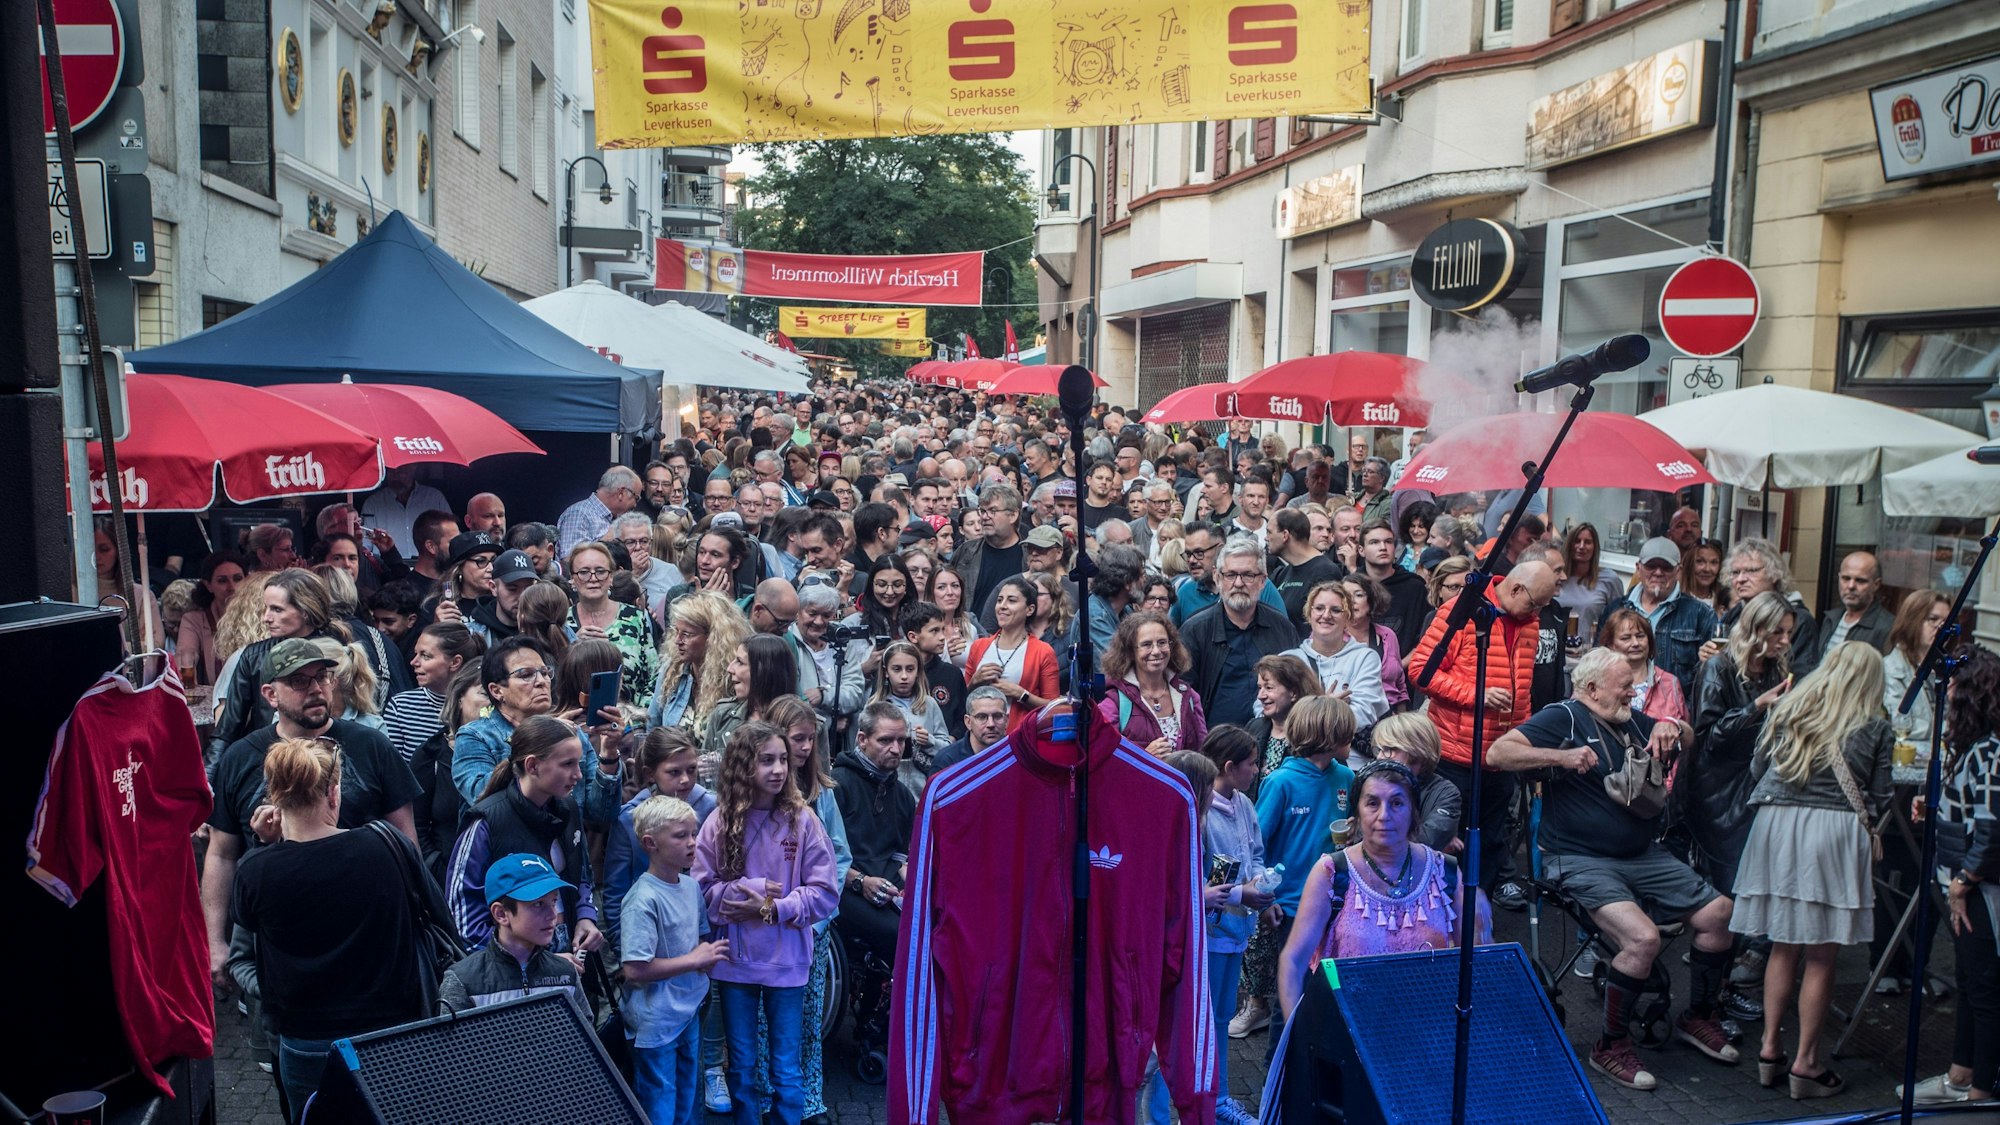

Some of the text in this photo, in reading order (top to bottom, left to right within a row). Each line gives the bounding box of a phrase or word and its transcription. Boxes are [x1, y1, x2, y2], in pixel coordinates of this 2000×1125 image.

[1229, 71, 1297, 87] Sparkasse
[950, 86, 1016, 101] Sparkasse
[1226, 89, 1301, 103] Leverkusen
[646, 100, 708, 116] Sparkasse
[947, 104, 1020, 117] Leverkusen
[644, 117, 712, 131] Leverkusen
[1899, 123, 1920, 143] früh
[1432, 239, 1481, 291] FELLINI
[818, 312, 885, 325] STREET LIFE
[1268, 395, 1302, 419] früh
[1362, 401, 1400, 424] früh
[393, 436, 444, 453] früh
[265, 452, 326, 490] früh
[1416, 464, 1449, 481] früh
[1656, 460, 1697, 477] früh
[514, 555, 527, 567] NY
